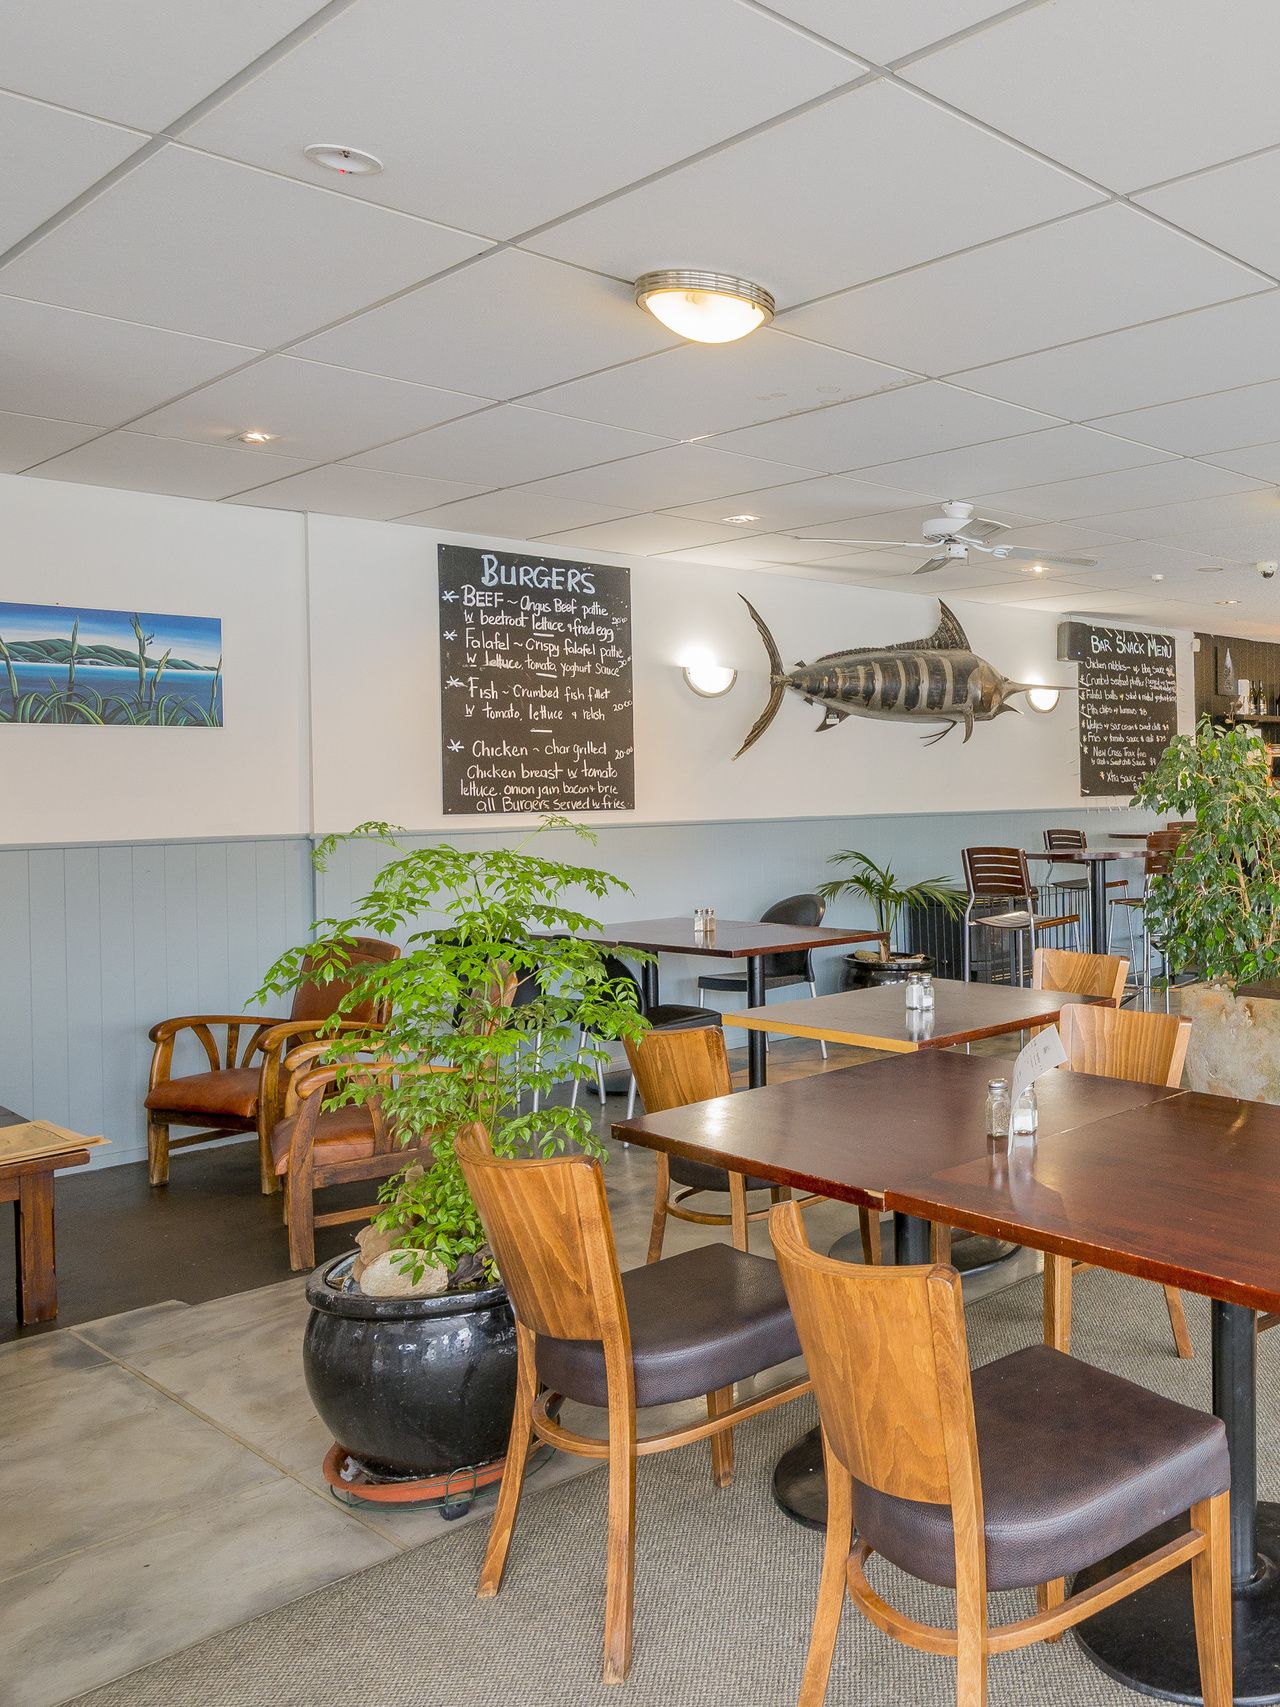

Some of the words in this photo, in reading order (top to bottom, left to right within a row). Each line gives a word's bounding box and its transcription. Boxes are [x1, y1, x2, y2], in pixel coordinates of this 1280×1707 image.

[481, 554, 596, 595] BURGERS
[461, 584, 504, 608] BEEF
[553, 598, 577, 614] Beef
[480, 609, 529, 628] beetroot
[532, 614, 565, 632] lettuce
[596, 626, 614, 643] egg
[465, 627, 510, 650] Falafel
[525, 638, 560, 657] Crispy
[563, 638, 596, 657] falafel
[1090, 635, 1112, 654] BAR
[1116, 635, 1145, 655] SNACK
[1147, 638, 1173, 659] MENU
[468, 676, 499, 700] Fish
[513, 684, 559, 699] Crumbed
[564, 686, 585, 702] fish
[587, 686, 611, 702] fillet
[529, 703, 563, 720] lettuce
[472, 740, 528, 757] Chicken
[544, 738, 570, 755] char
[572, 740, 607, 763] grilled
[467, 764, 516, 779] Chicken
[521, 762, 563, 779] breast
[581, 759, 618, 778] tomato
[504, 784, 535, 795] onion
[562, 781, 589, 794] bacon
[597, 781, 618, 794] brie
[476, 797, 496, 813] all
[502, 796, 550, 813] Burgers
